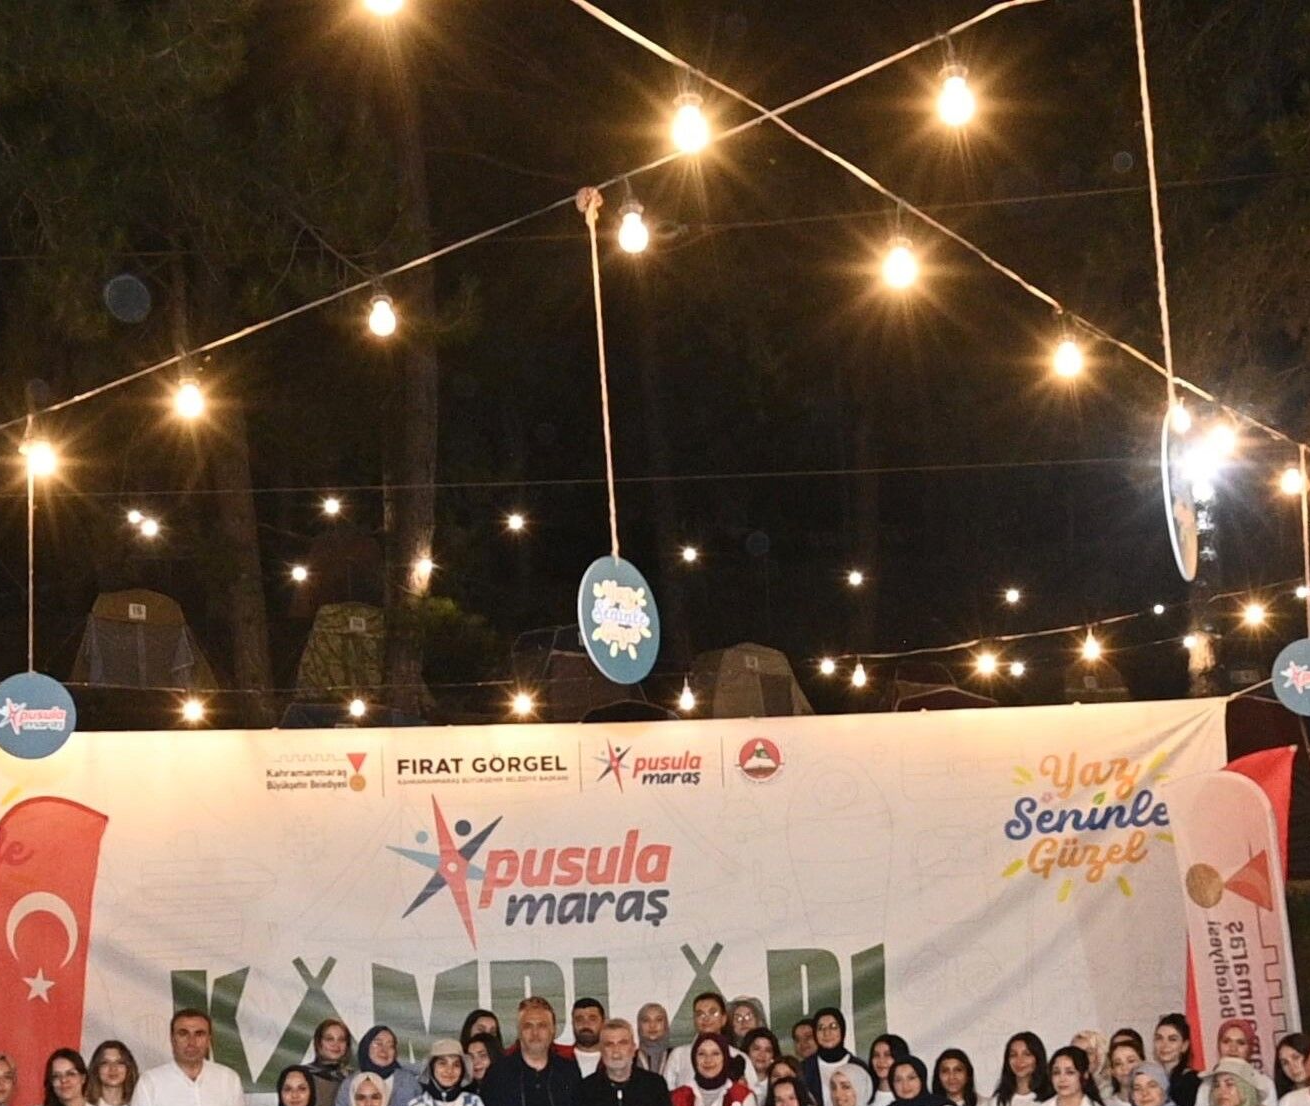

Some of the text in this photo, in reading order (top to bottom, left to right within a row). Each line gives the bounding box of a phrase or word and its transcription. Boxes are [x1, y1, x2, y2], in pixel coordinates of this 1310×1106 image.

[266, 767, 347, 779] Kahramanmaraş
[397, 754, 567, 775] FIRAT GÖRGEL
[633, 751, 702, 778] pusula
[642, 771, 701, 785] maraş
[1040, 752, 1140, 800] Yaz
[1004, 790, 1170, 840] Seninle
[478, 829, 672, 909] pusula
[1027, 831, 1148, 883] Güzel
[505, 889, 670, 927] maraş
